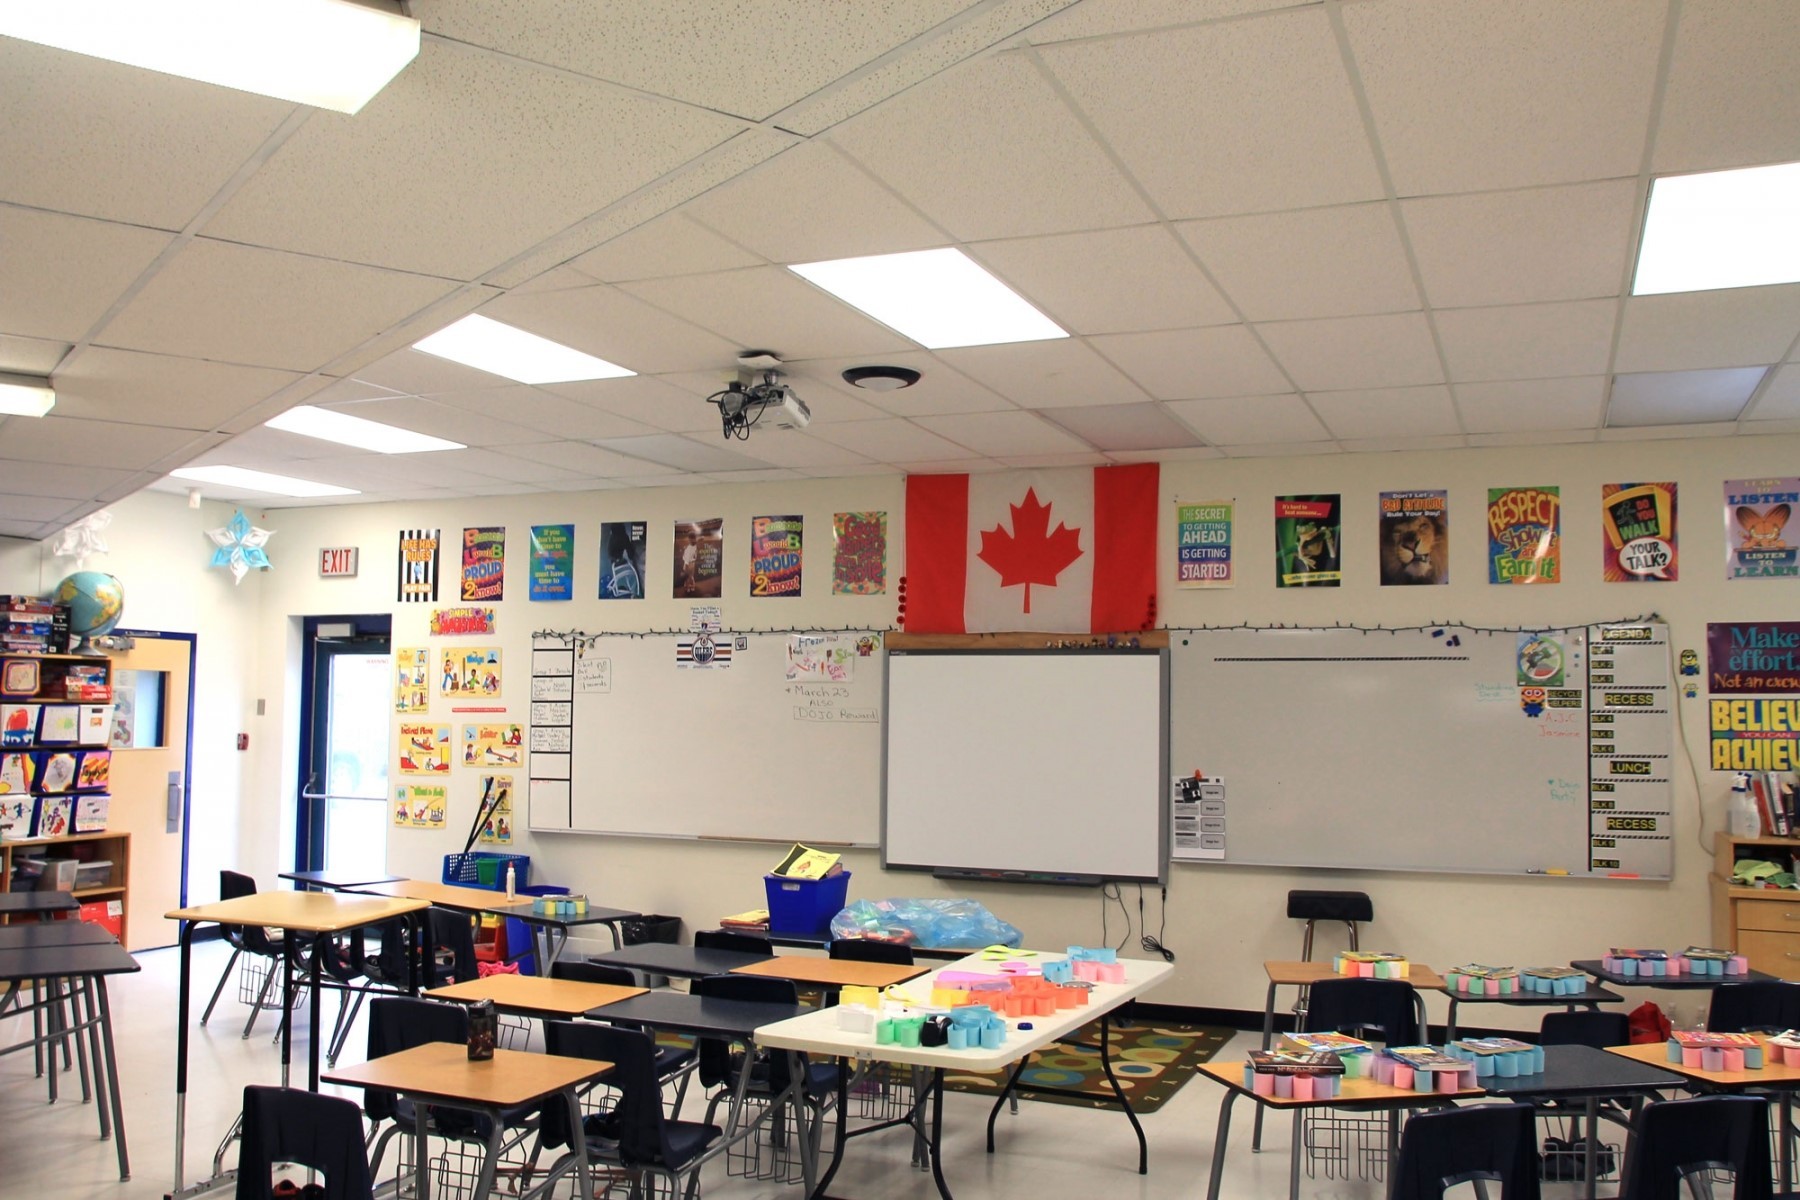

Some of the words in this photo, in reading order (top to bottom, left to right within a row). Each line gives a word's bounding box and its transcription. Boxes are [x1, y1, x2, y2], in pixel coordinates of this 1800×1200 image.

[1382, 500, 1402, 511] BAD
[1403, 499, 1445, 510] ATTITUDE
[1636, 499, 1649, 510] DO
[1728, 492, 1799, 505] LISTEN
[1183, 509, 1194, 520] THE
[1195, 508, 1226, 520] SECRET
[1489, 490, 1559, 537] RESPECT
[1636, 508, 1656, 520] YOU
[1182, 530, 1227, 544] AHEAD
[1619, 521, 1659, 540] WALK
[401, 540, 419, 551] LIFE
[420, 539, 437, 549] HAS
[1499, 526, 1542, 552] Show
[1182, 549, 1190, 559] IS
[1191, 548, 1227, 559] GETTING
[1629, 541, 1661, 555] YOUR
[322, 549, 351, 573] EXIT
[406, 551, 431, 561] RULES
[1626, 553, 1667, 570] TALK?
[464, 560, 502, 580] PROUD
[754, 553, 800, 574] PROUD
[1496, 554, 1537, 582] Earn
[1540, 556, 1555, 579] it
[1182, 563, 1227, 579] STARTED
[1733, 566, 1799, 577] LEARN
[463, 580, 476, 599] 2
[474, 582, 501, 598] know!
[752, 573, 768, 595] 2
[767, 575, 799, 593] know!
[449, 608, 473, 617] SIMPLE
[1603, 628, 1651, 640] AGENDA
[1730, 626, 1800, 649] Make
[1728, 649, 1800, 671] effort.
[1713, 673, 1742, 689] Not
[1744, 677, 1762, 688] an
[794, 685, 830, 698] March
[832, 687, 849, 698] 23
[1548, 690, 1582, 698] RECYCLE
[1605, 693, 1653, 705] RECESS
[798, 707, 833, 720] DOJO
[840, 708, 876, 720] Reward
[1610, 762, 1651, 773] LUNCH
[1607, 818, 1656, 829] RECESS
